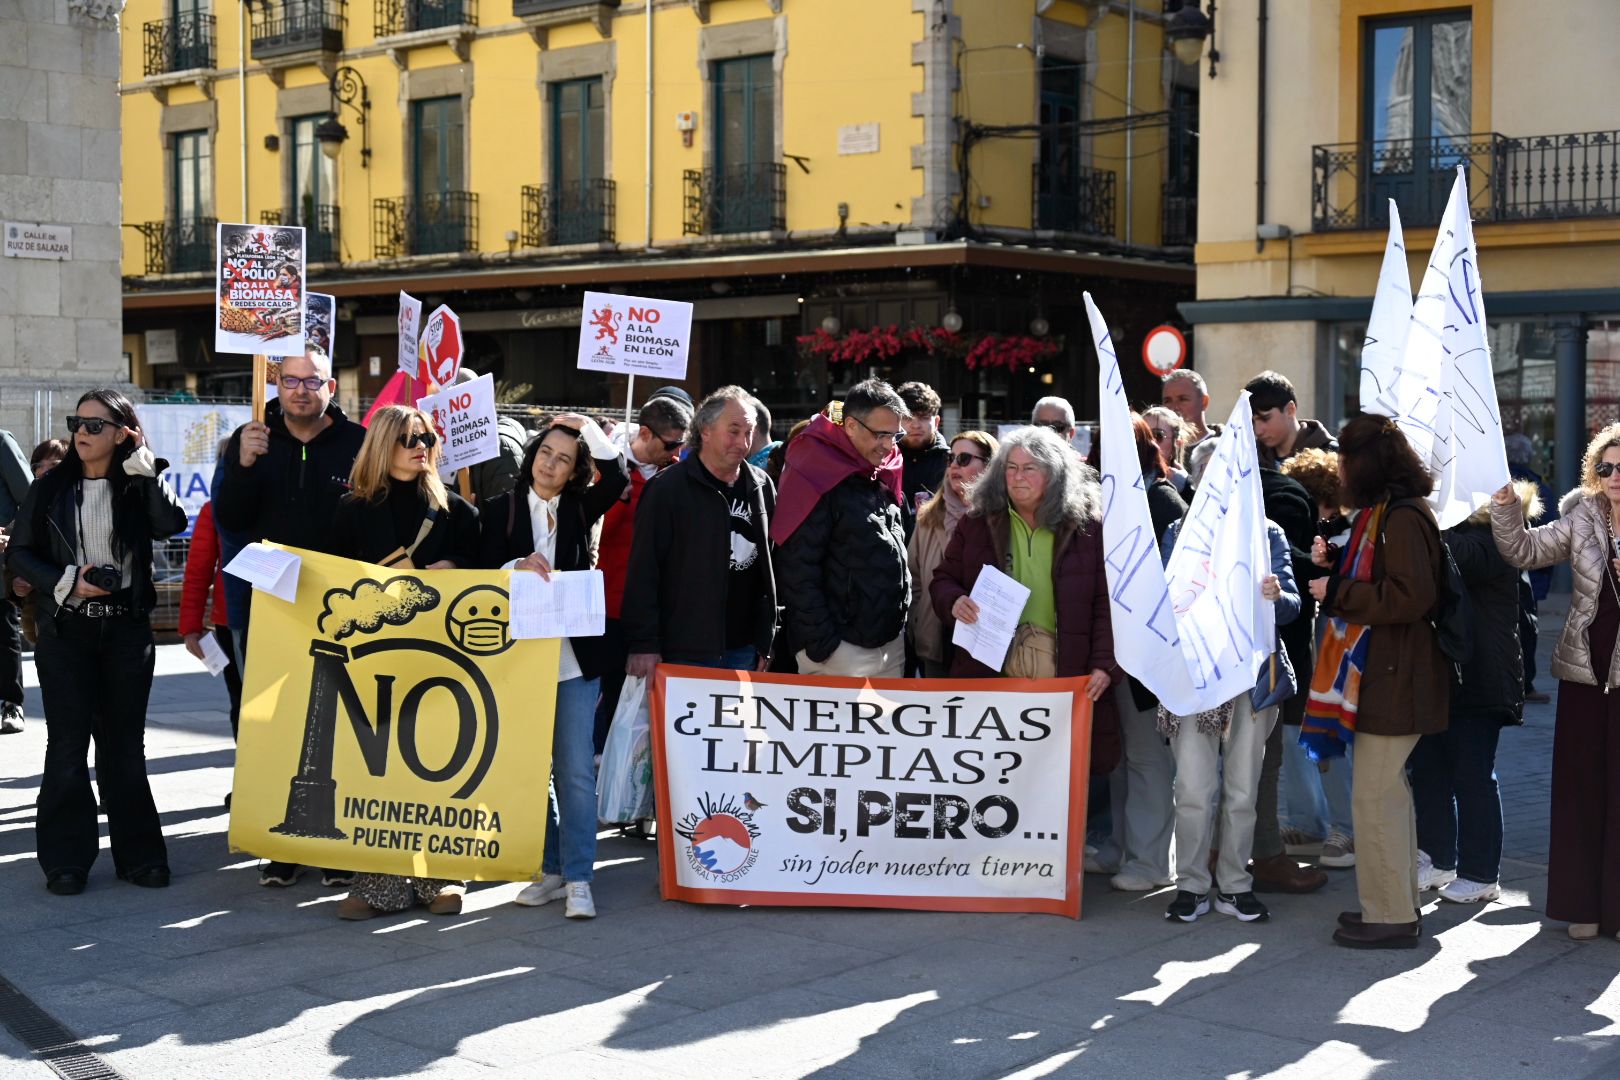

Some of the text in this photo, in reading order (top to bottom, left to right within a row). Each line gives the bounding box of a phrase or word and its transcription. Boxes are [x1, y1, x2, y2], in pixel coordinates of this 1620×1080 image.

[24, 231, 47, 240] CALLE
[7, 241, 69, 253] RUIZ DE SALAZAR
[227, 258, 248, 268] NO
[229, 289, 294, 300] BIOMASA
[628, 306, 661, 324] NO
[430, 318, 443, 336] STOP
[626, 323, 653, 334] A LA
[624, 344, 674, 357] EN LEÓN
[625, 334, 680, 348] BIOMASA
[449, 393, 472, 414] NO
[451, 412, 469, 425] A LA
[451, 416, 491, 437] BIOMASA
[452, 428, 487, 448] EN LEÓN
[673, 693, 1052, 742] ¿ENERGÍAS
[701, 738, 1023, 785] LIMPIAS?
[343, 797, 502, 833] INCINERADORA
[675, 791, 762, 842] Alta Valduerna
[352, 826, 501, 859] PUENTE CASTRO
[684, 845, 760, 884] NATURAL Y SOSTENIBLE
[779, 849, 1056, 886] sin joder nuestra tierra
